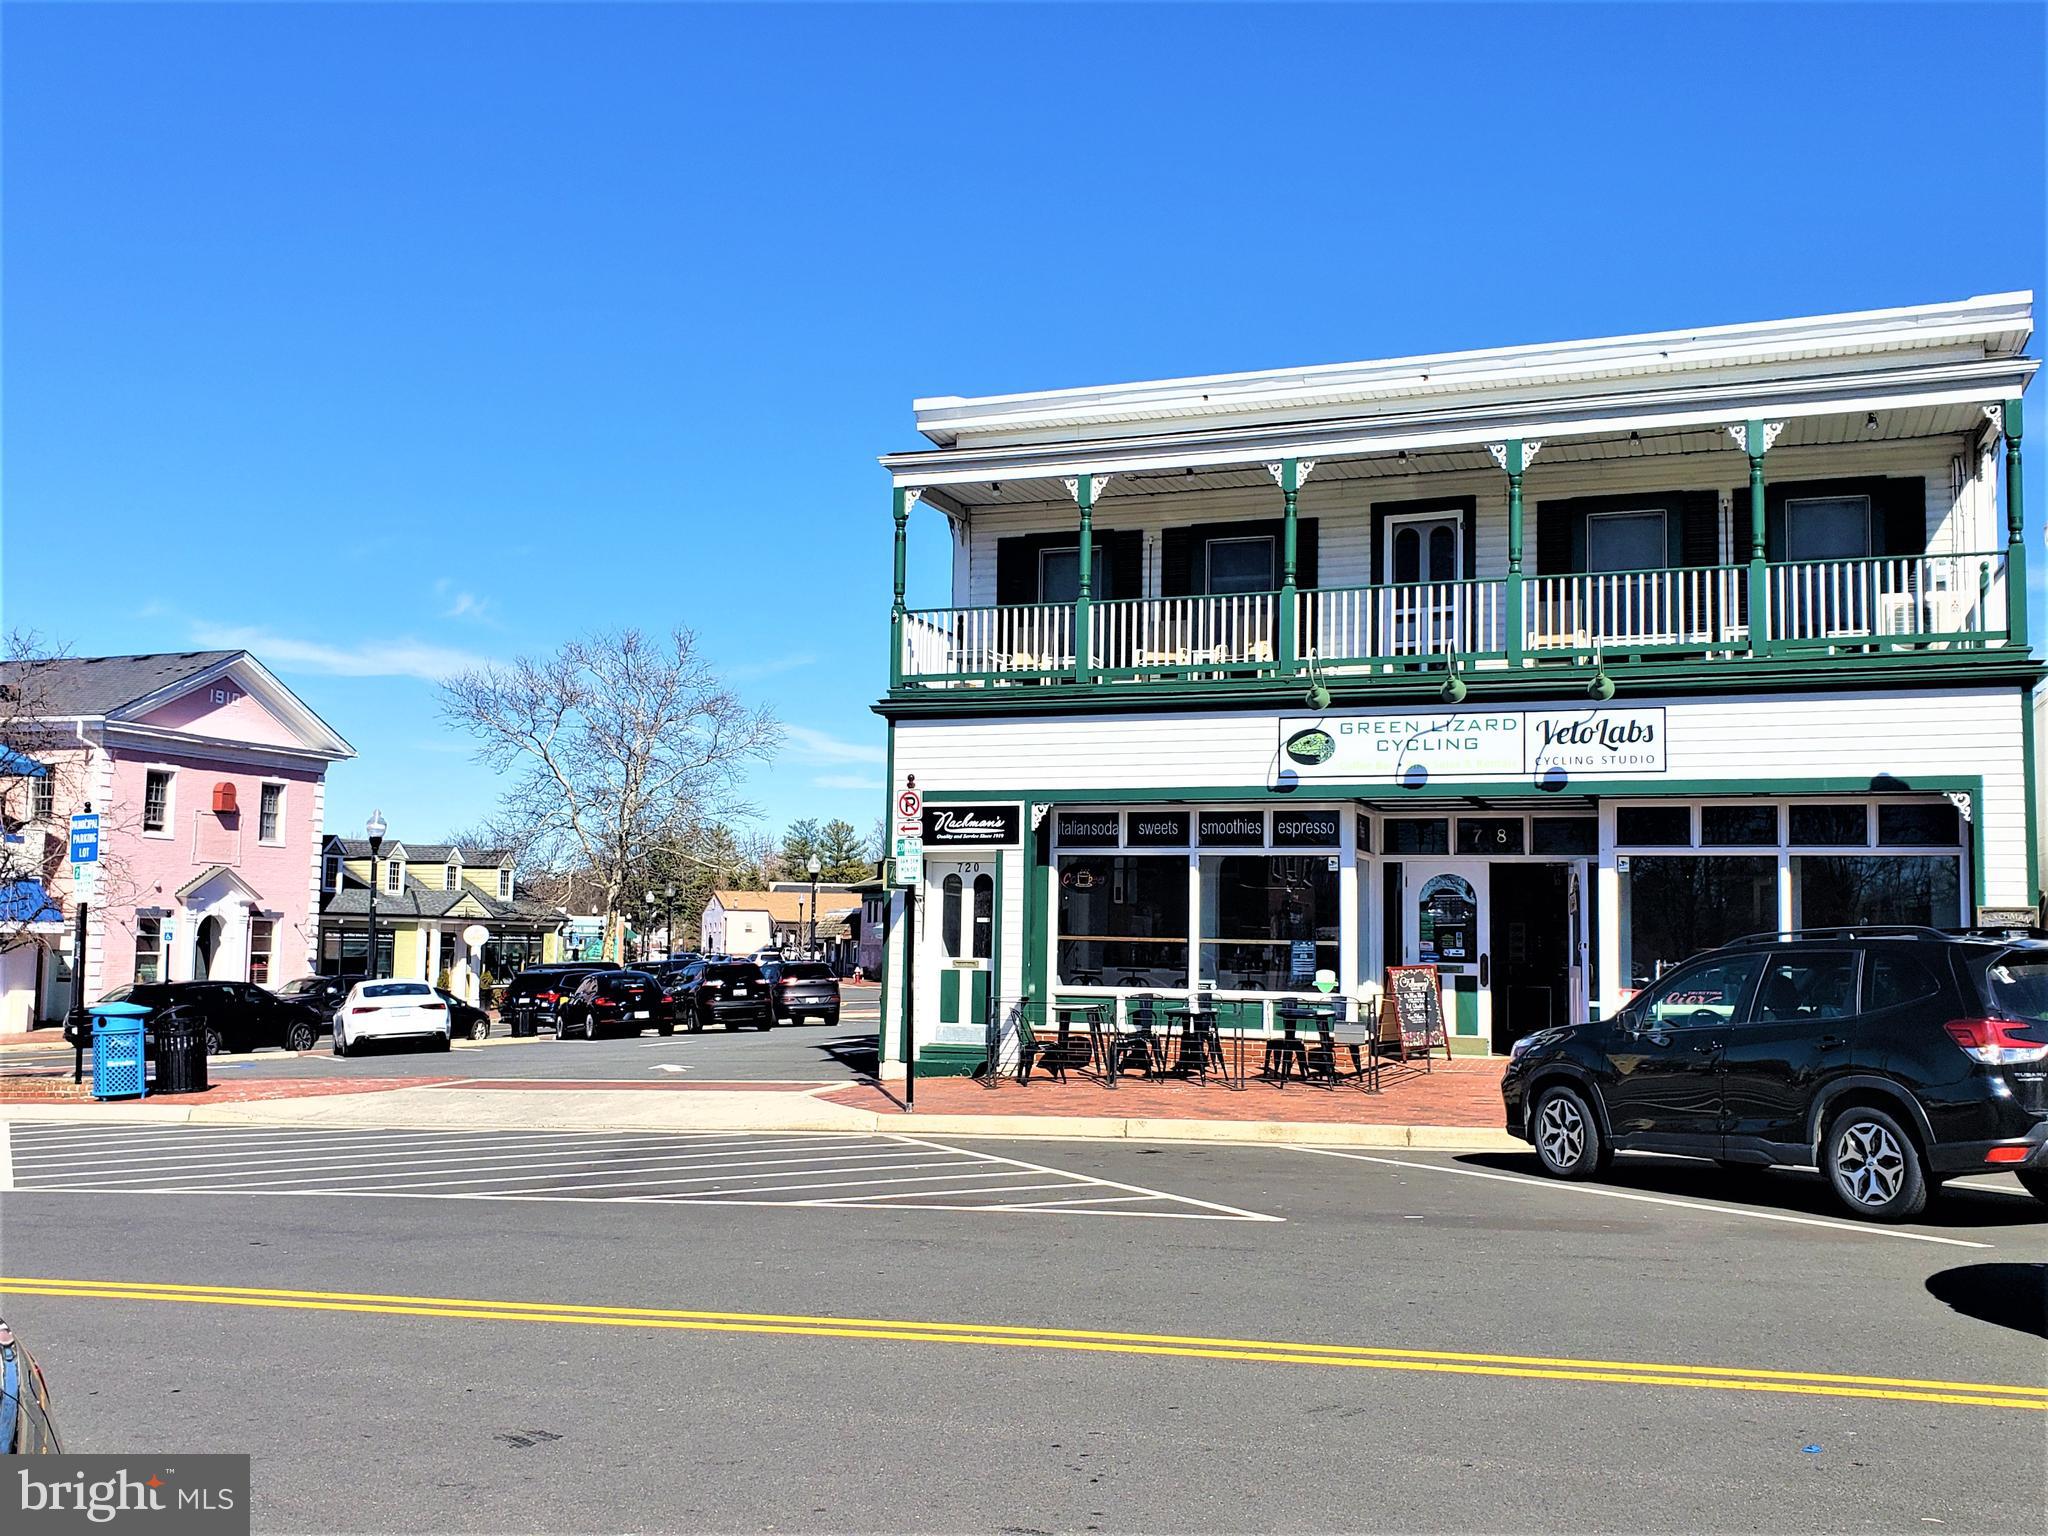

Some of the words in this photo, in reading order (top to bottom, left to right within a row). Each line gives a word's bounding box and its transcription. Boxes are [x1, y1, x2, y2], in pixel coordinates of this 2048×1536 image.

[1340, 721, 1419, 735] GREEN
[1432, 718, 1518, 732] LIZARD
[1376, 737, 1479, 752] CYCLING
[1536, 755, 1594, 766] CYCLING
[1601, 754, 1655, 765] STUDIO
[932, 811, 1006, 833] Nachman's
[1138, 820, 1179, 835] sweets
[1201, 818, 1262, 835] smoothies
[1278, 821, 1335, 838] espresso
[72, 833, 97, 844] PARKING
[79, 847, 90, 857] LOT
[957, 862, 980, 873] 720
